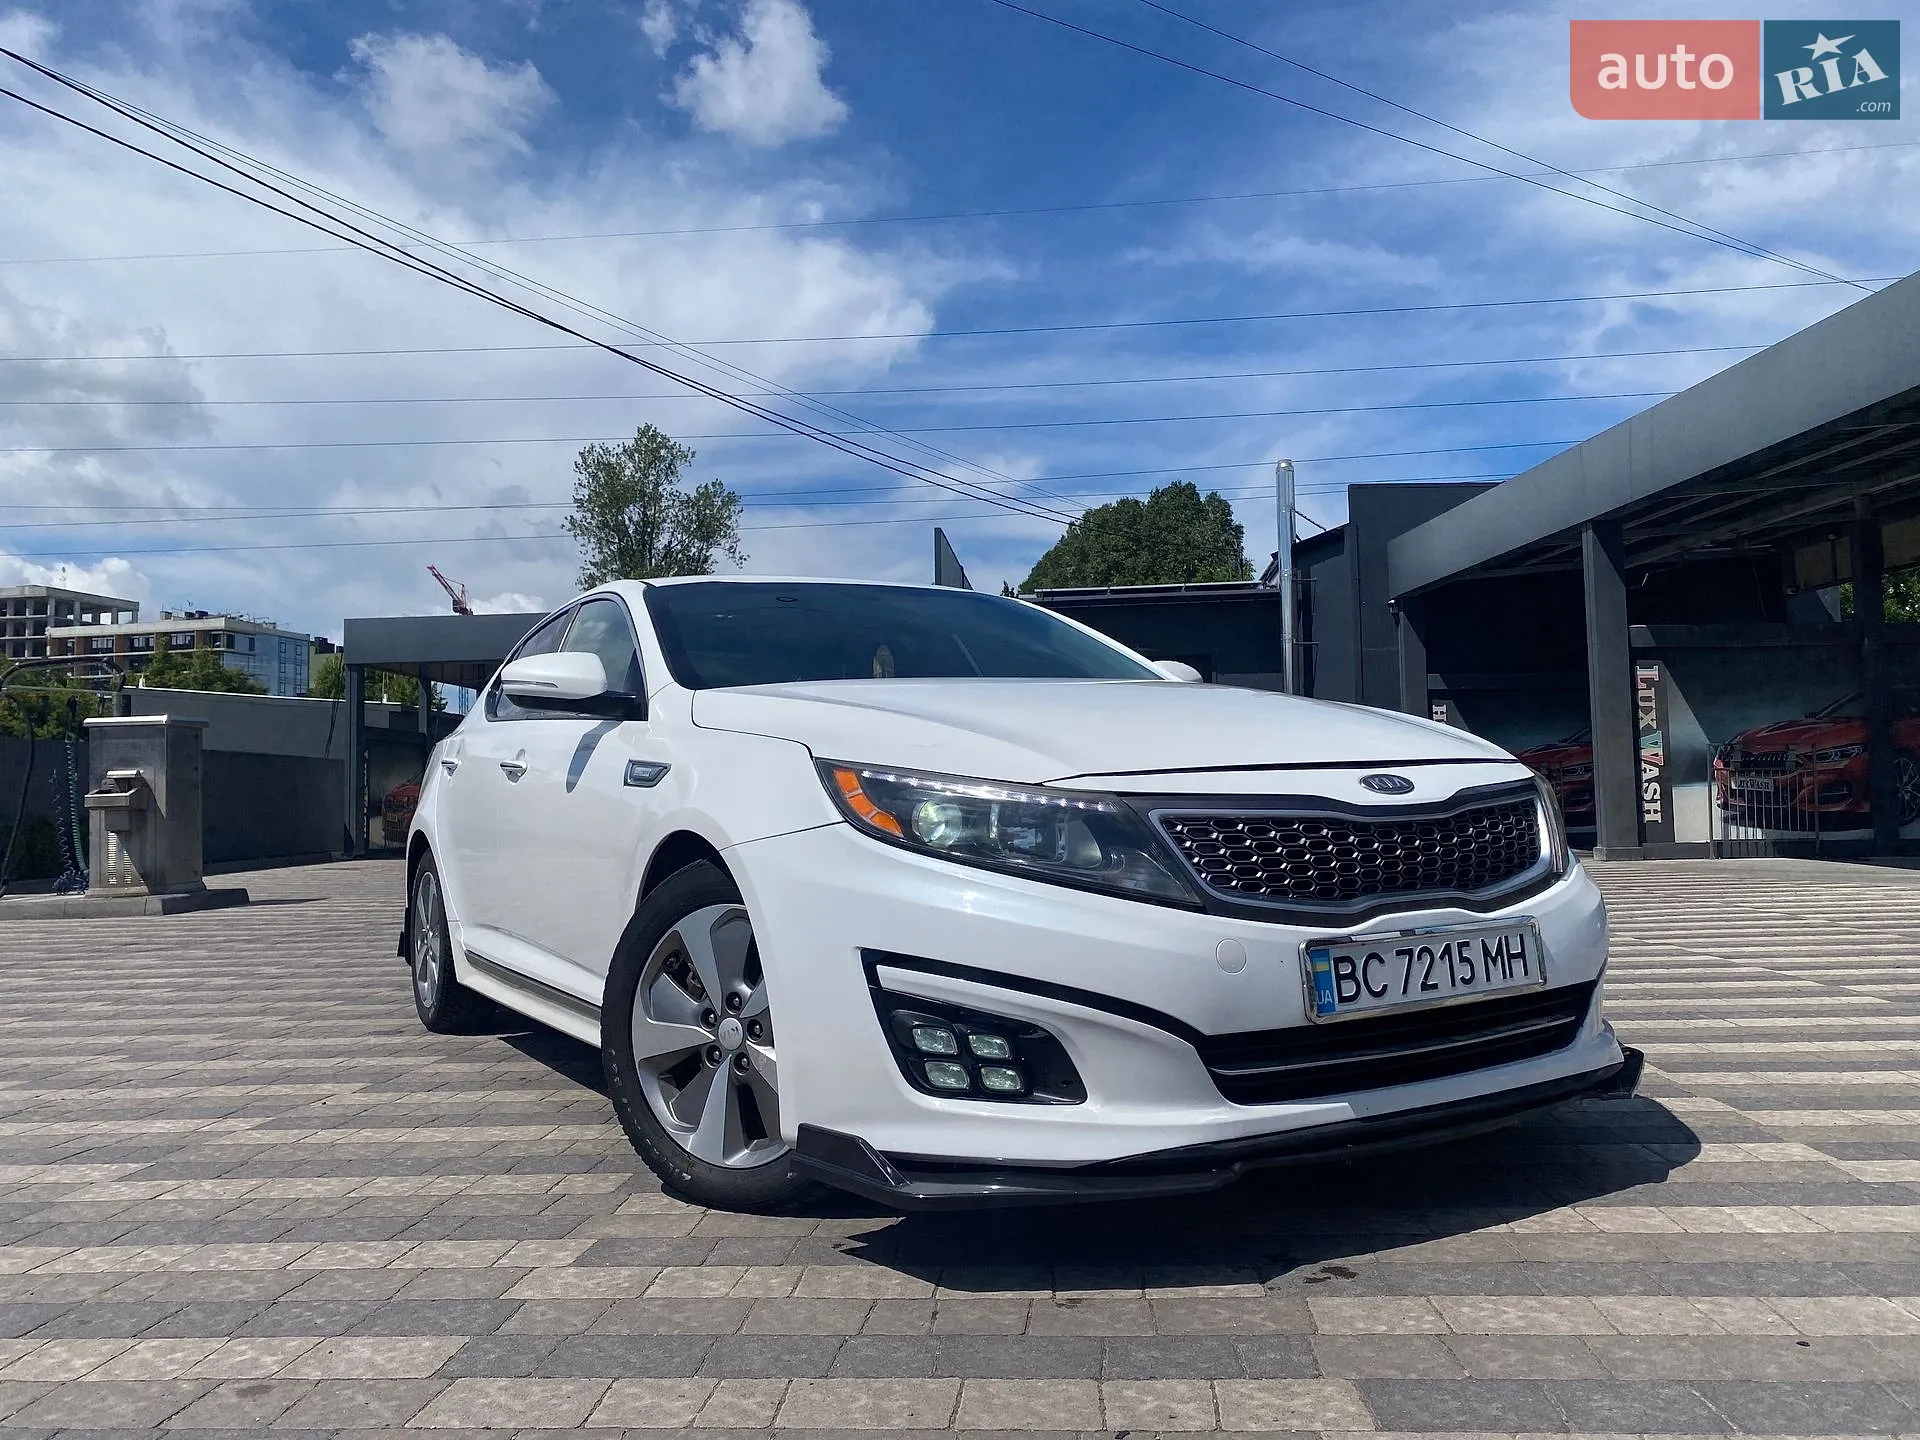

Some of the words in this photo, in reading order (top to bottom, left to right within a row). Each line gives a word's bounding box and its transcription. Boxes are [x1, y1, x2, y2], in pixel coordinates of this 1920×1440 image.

[1333, 952, 1388, 1004] BC
[1395, 939, 1476, 995] 7215
[1480, 933, 1529, 982] MH
[1317, 991, 1333, 1005] UA
